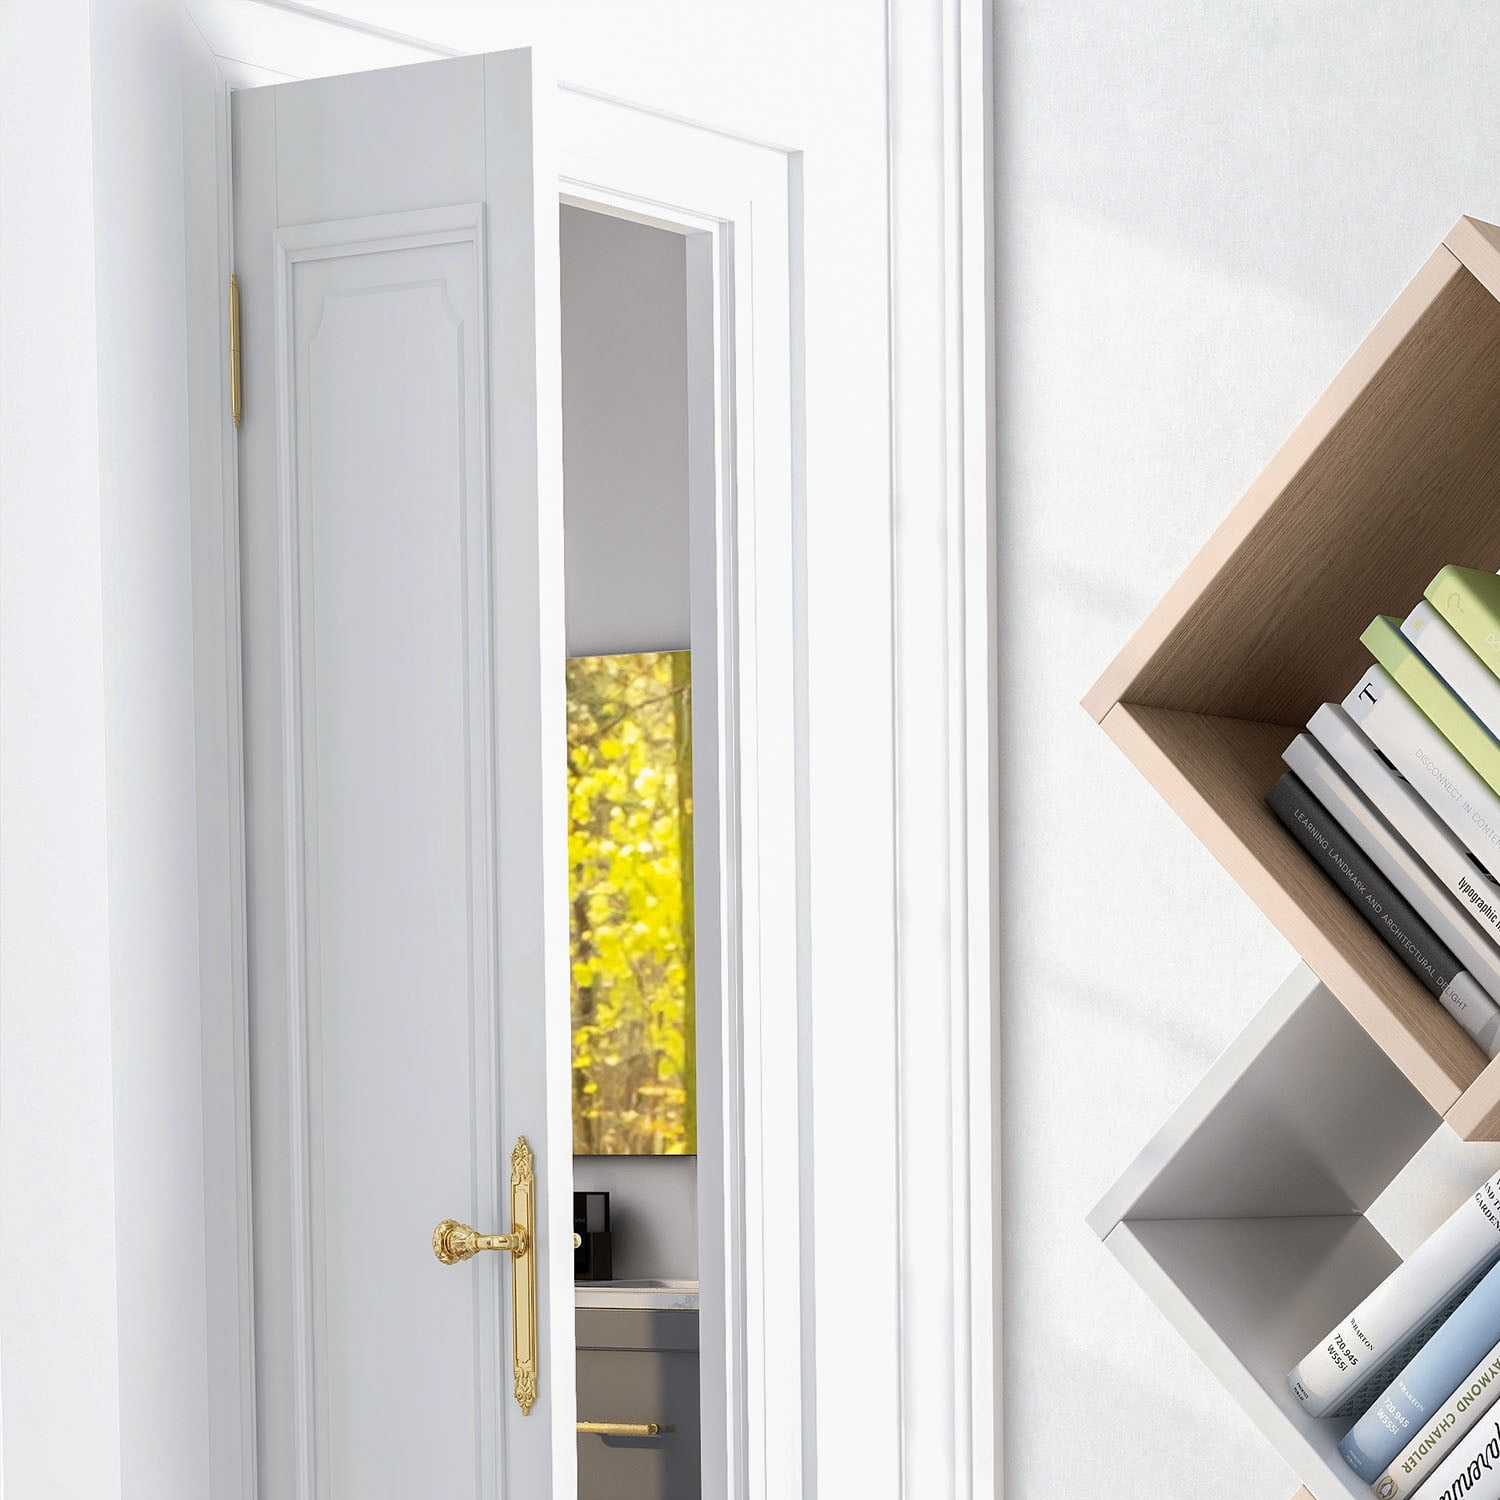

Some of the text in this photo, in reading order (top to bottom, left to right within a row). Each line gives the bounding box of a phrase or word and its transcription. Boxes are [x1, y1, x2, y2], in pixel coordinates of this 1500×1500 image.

[1359, 683, 1378, 705] T
[1415, 749, 1463, 802] DISCONNECT
[1463, 799, 1472, 812] IN
[1294, 809, 1468, 1012] LEARNING LANDMARK AND ARCHITECTURAL DELIGHT
[1458, 877, 1496, 923] typographic
[1334, 1334, 1359, 1366] 720.945
[1383, 1397, 1410, 1428] 720.945
[1401, 1413, 1457, 1473] CHANDLER
